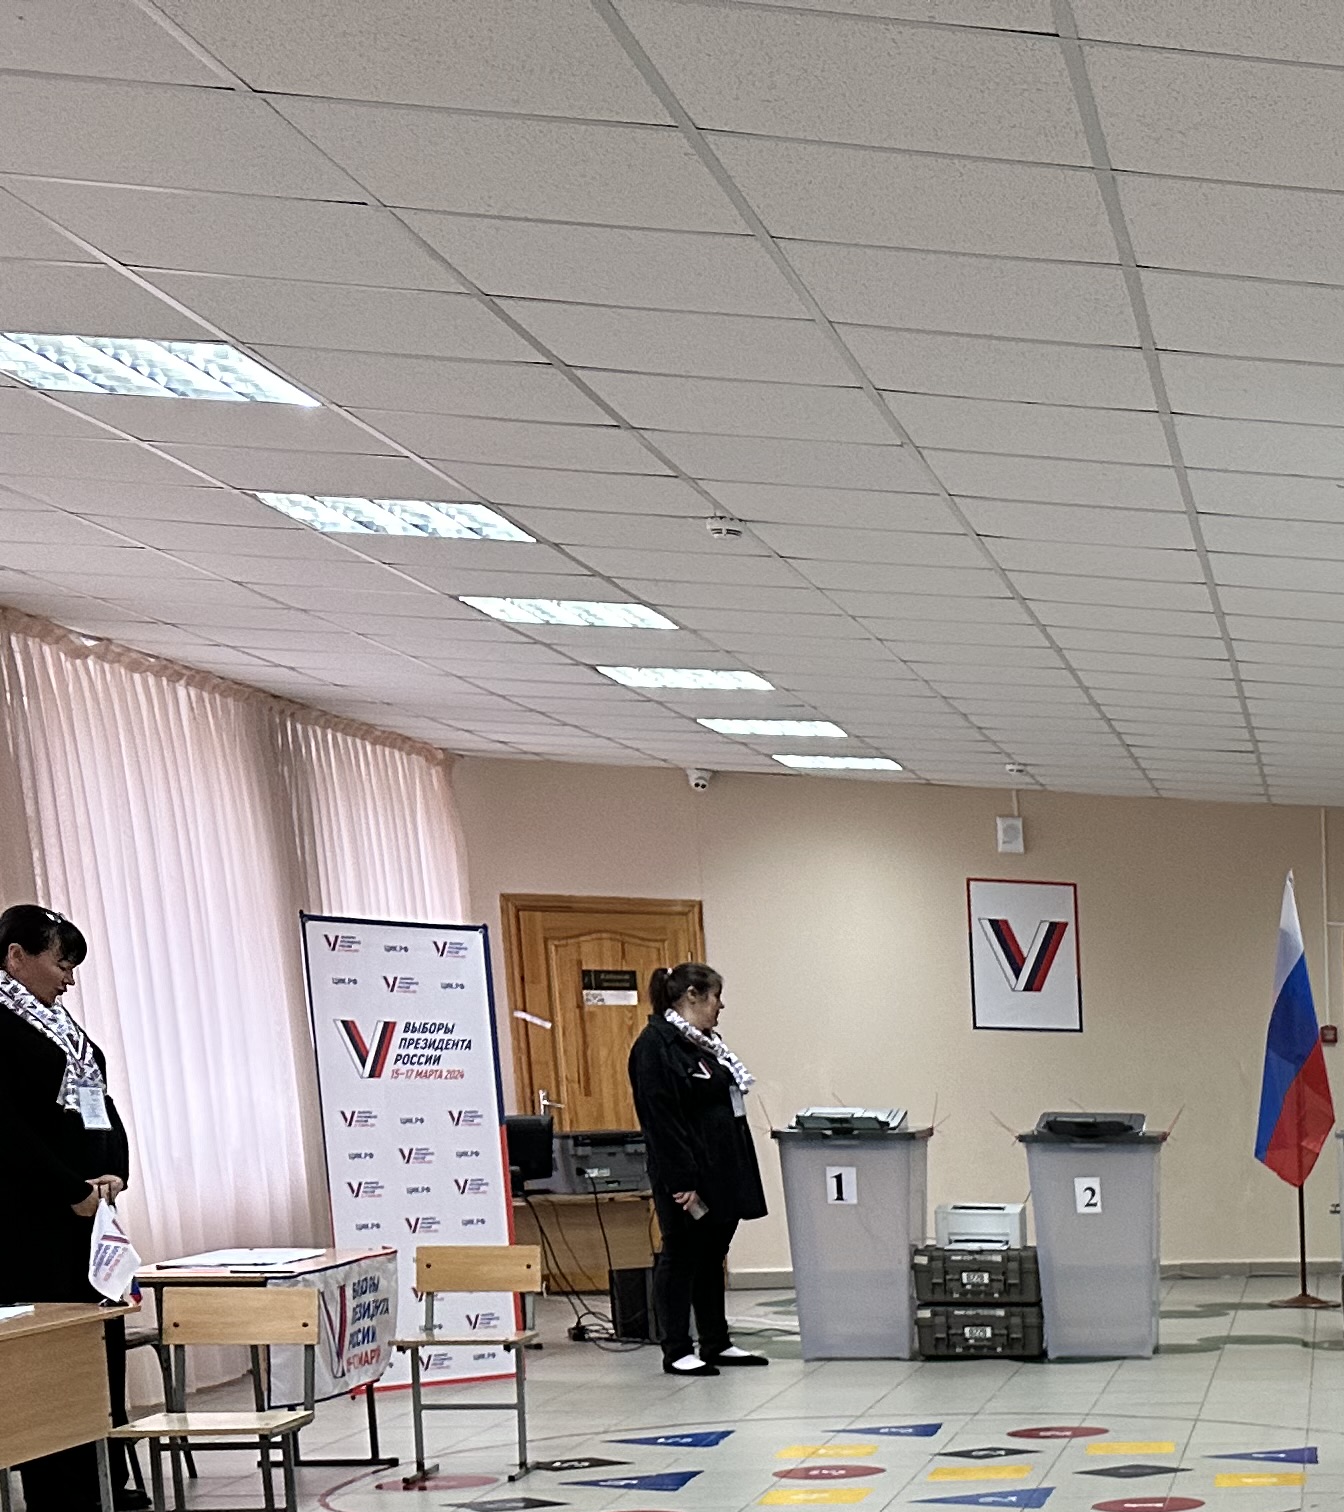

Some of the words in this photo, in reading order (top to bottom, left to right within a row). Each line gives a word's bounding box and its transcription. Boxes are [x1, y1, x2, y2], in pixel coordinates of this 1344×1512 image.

[403, 1021, 455, 1035] ВЫБОРЫ
[398, 1037, 472, 1052] ПРЕЗИДЕНТА
[393, 1053, 442, 1066] РОССИИ
[414, 1069, 443, 1080] МАРТА
[830, 1172, 848, 1202] 1
[1084, 1186, 1099, 1208] 2
